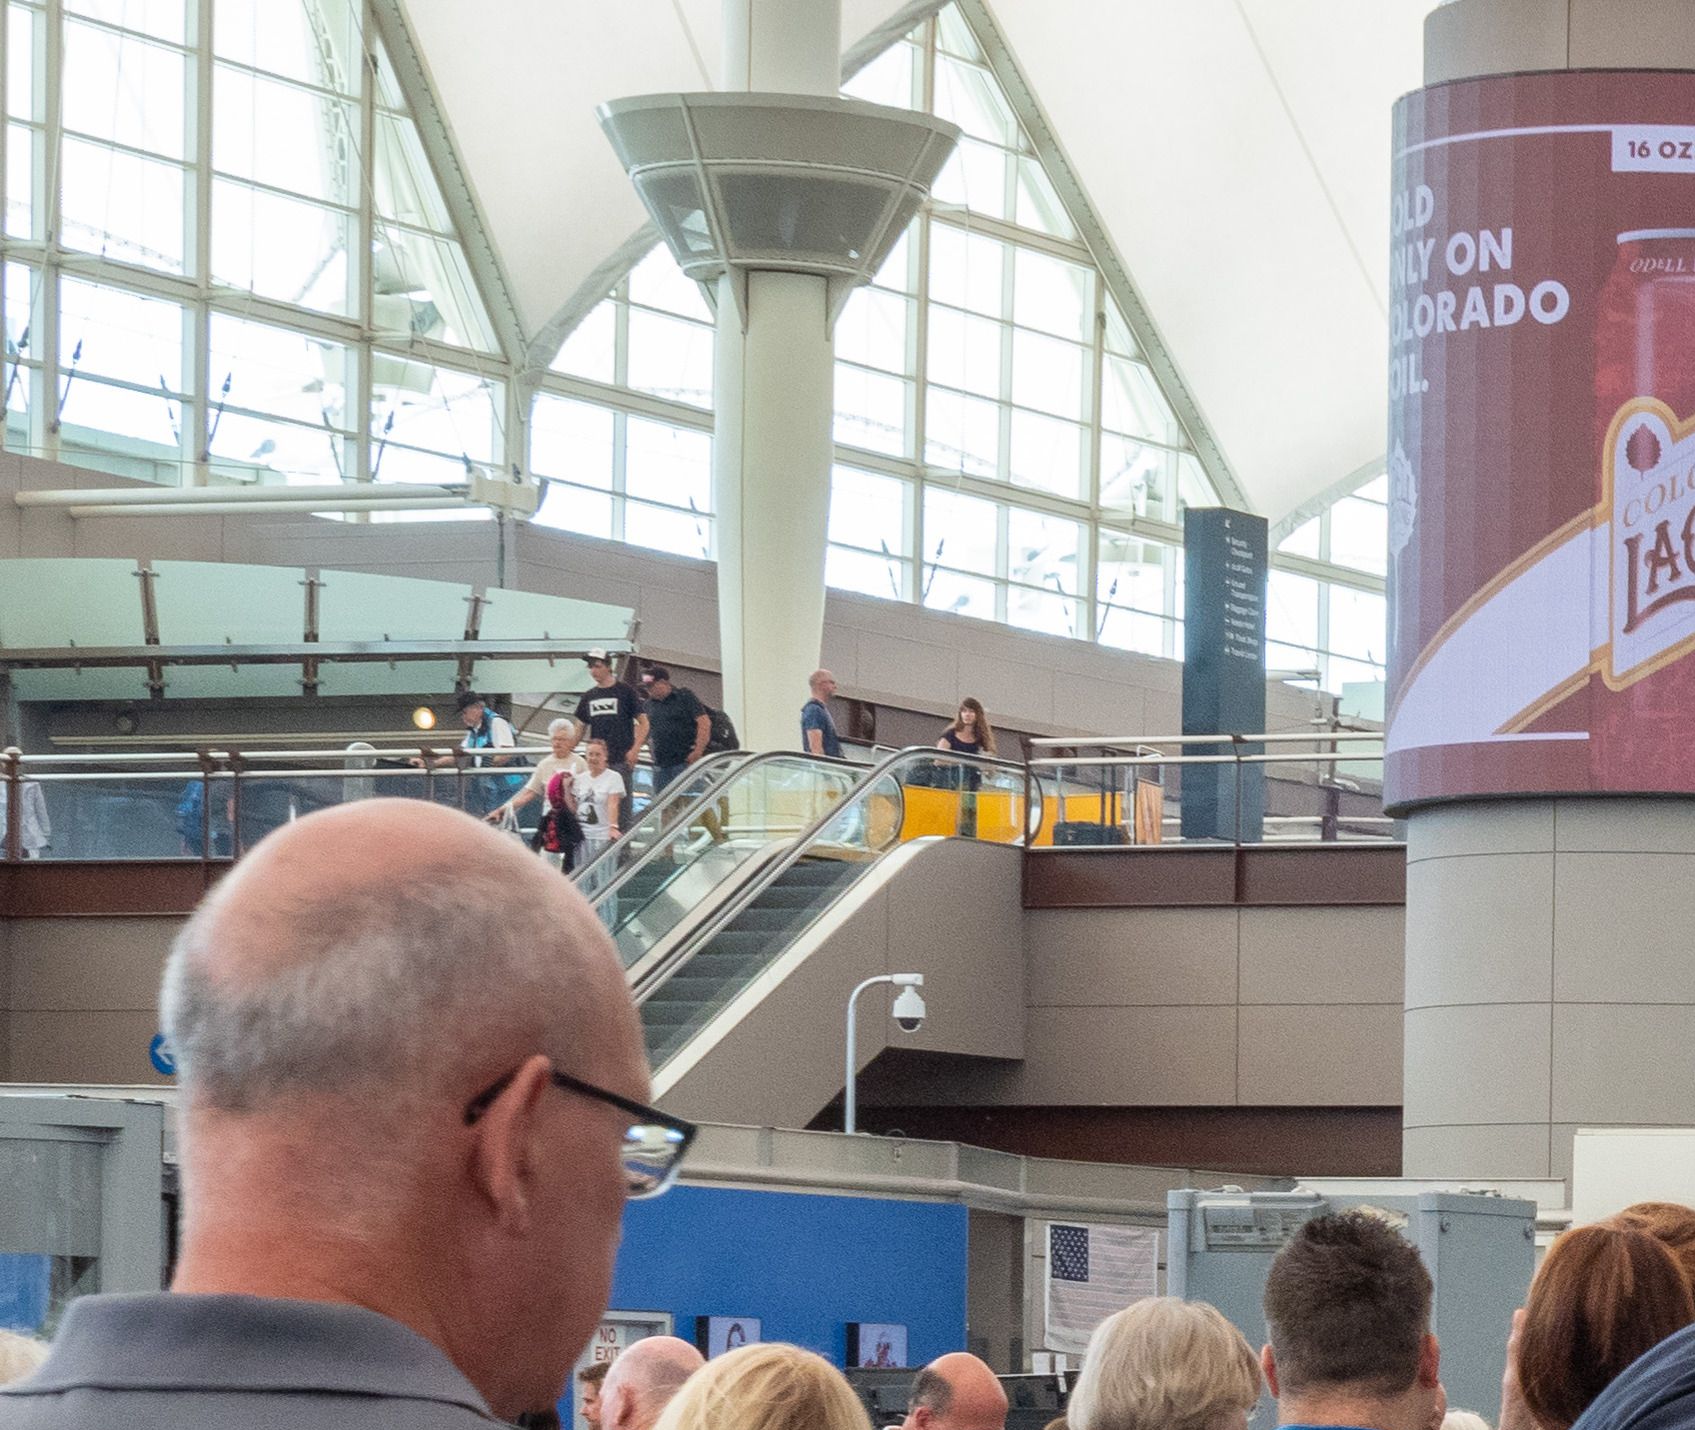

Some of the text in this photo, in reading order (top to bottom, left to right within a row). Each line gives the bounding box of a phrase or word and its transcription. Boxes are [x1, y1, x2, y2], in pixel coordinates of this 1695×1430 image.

[1628, 141, 1650, 158] 16
[1446, 227, 1513, 276] ON
[1629, 257, 1686, 274] ODELL
[599, 1327, 617, 1343] NO
